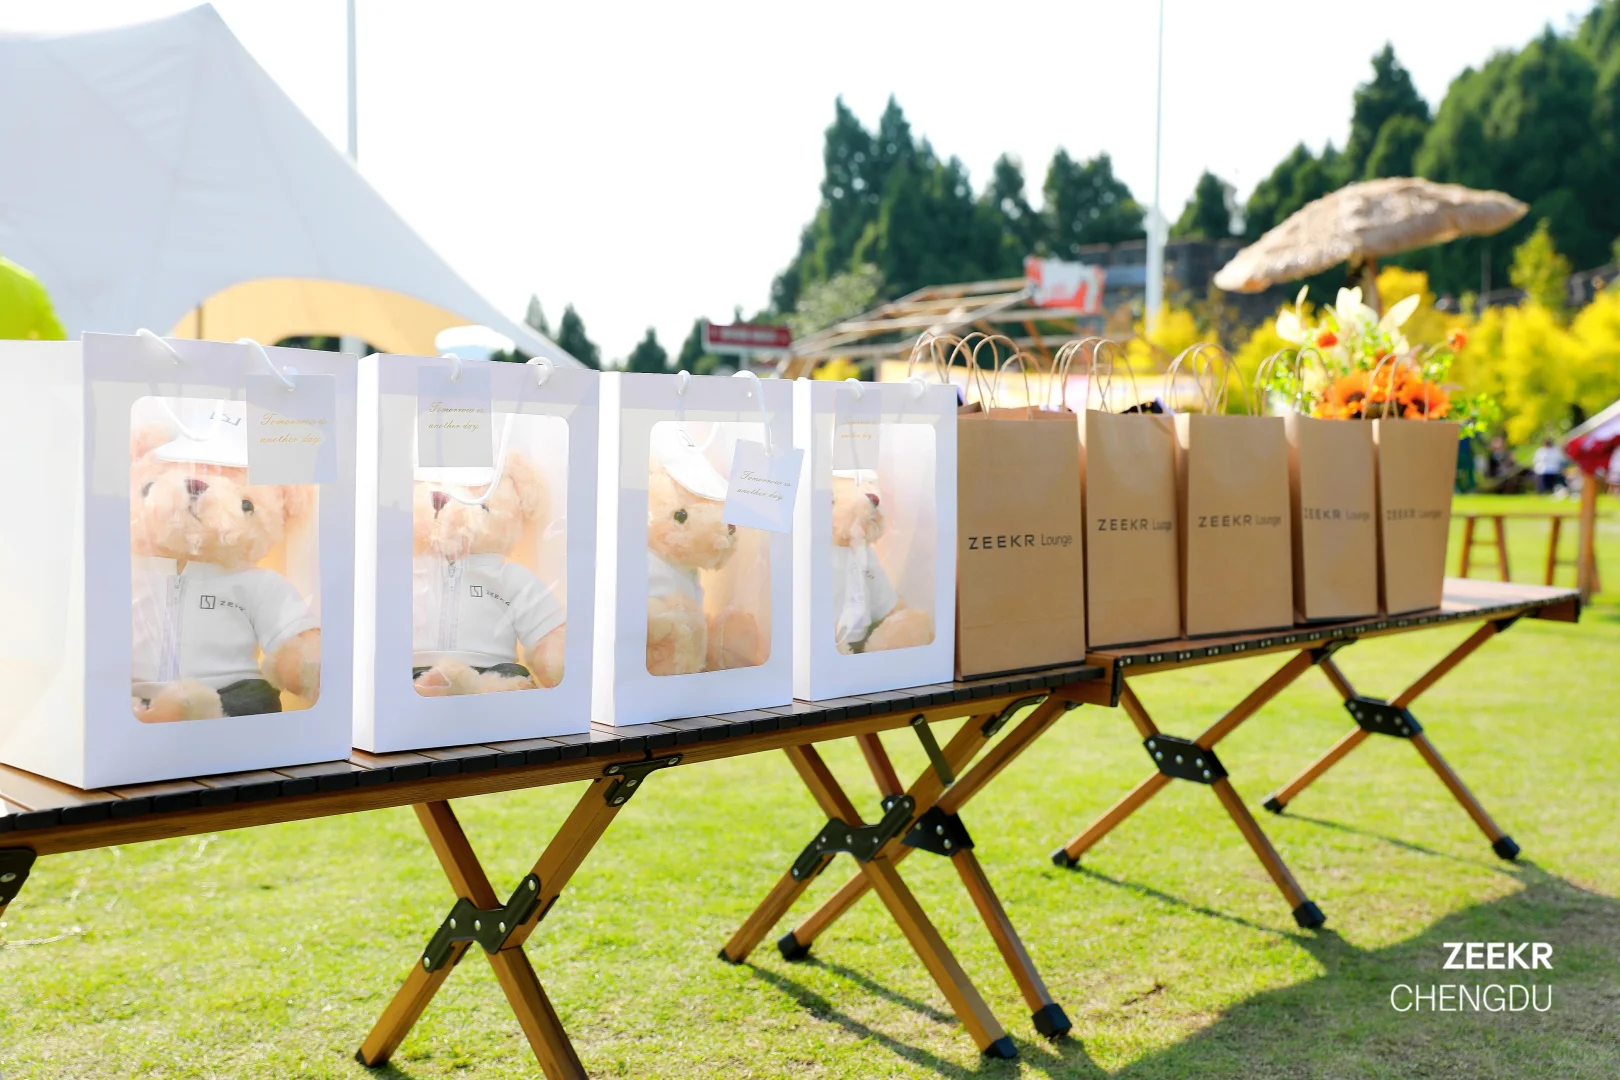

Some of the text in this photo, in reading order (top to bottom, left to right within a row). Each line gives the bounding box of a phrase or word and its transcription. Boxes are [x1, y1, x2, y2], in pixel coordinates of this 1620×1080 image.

[428, 401, 475, 414] Tomorrow
[260, 412, 316, 426] Tomorrow
[428, 420, 461, 429] another
[260, 432, 321, 446] another day
[740, 470, 783, 485] Tomorrow
[736, 488, 766, 497] another
[1304, 507, 1342, 520] ZEEKR
[1386, 508, 1417, 522] ZEEKR
[1097, 518, 1149, 532] ZEEKR
[1198, 514, 1282, 528] ZEEKR Lounge
[968, 533, 1074, 550] ZEEKR Lounge
